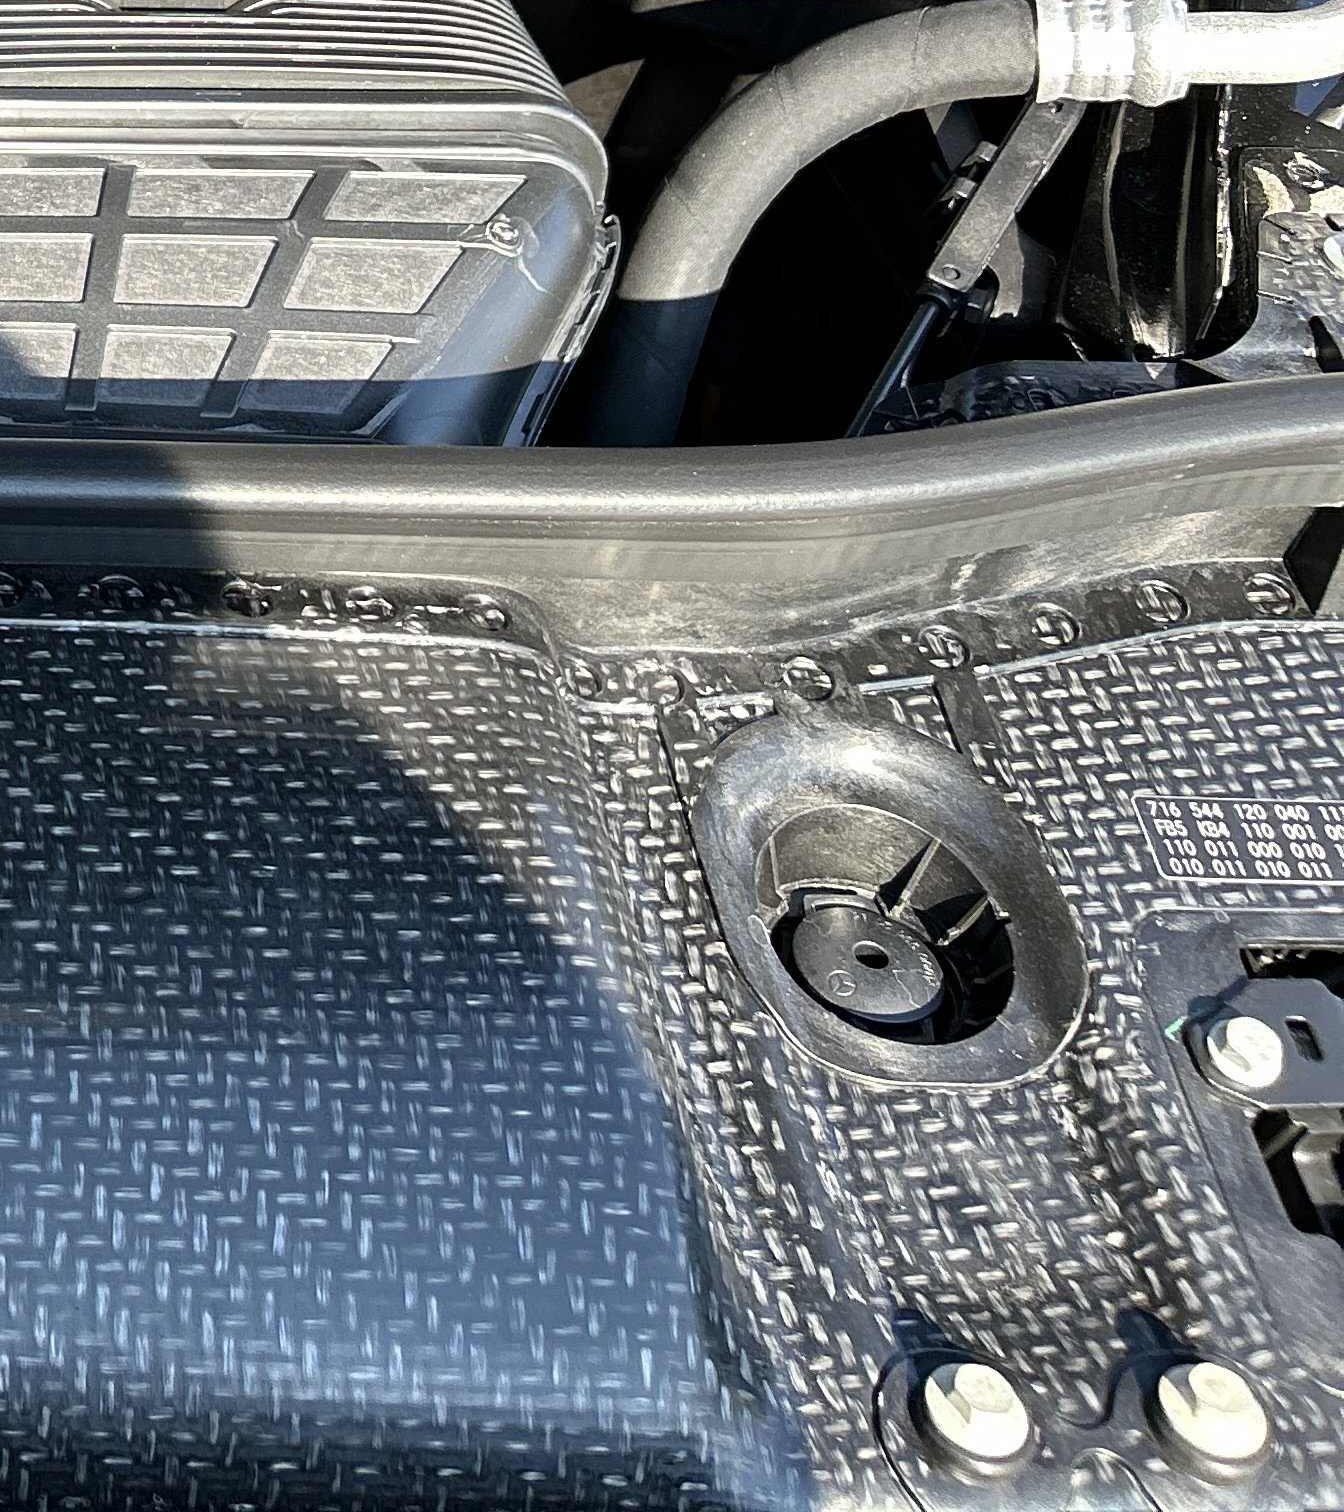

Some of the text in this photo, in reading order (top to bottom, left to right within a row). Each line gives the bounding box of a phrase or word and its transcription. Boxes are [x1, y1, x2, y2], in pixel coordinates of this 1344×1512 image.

[1145, 799, 1182, 818] 716
[1188, 801, 1224, 820] 544
[1232, 802, 1268, 821] 120
[1273, 803, 1310, 822] 040
[1152, 818, 1188, 837] FB5
[1196, 819, 1231, 839] KB4
[1240, 822, 1275, 840] 110
[1281, 823, 1317, 841] 001
[1162, 838, 1197, 857] 110
[1203, 839, 1239, 858] 011
[1247, 841, 1283, 859] 000
[1289, 841, 1326, 860] 010
[1168, 857, 1333, 879] 010 011 010 011
